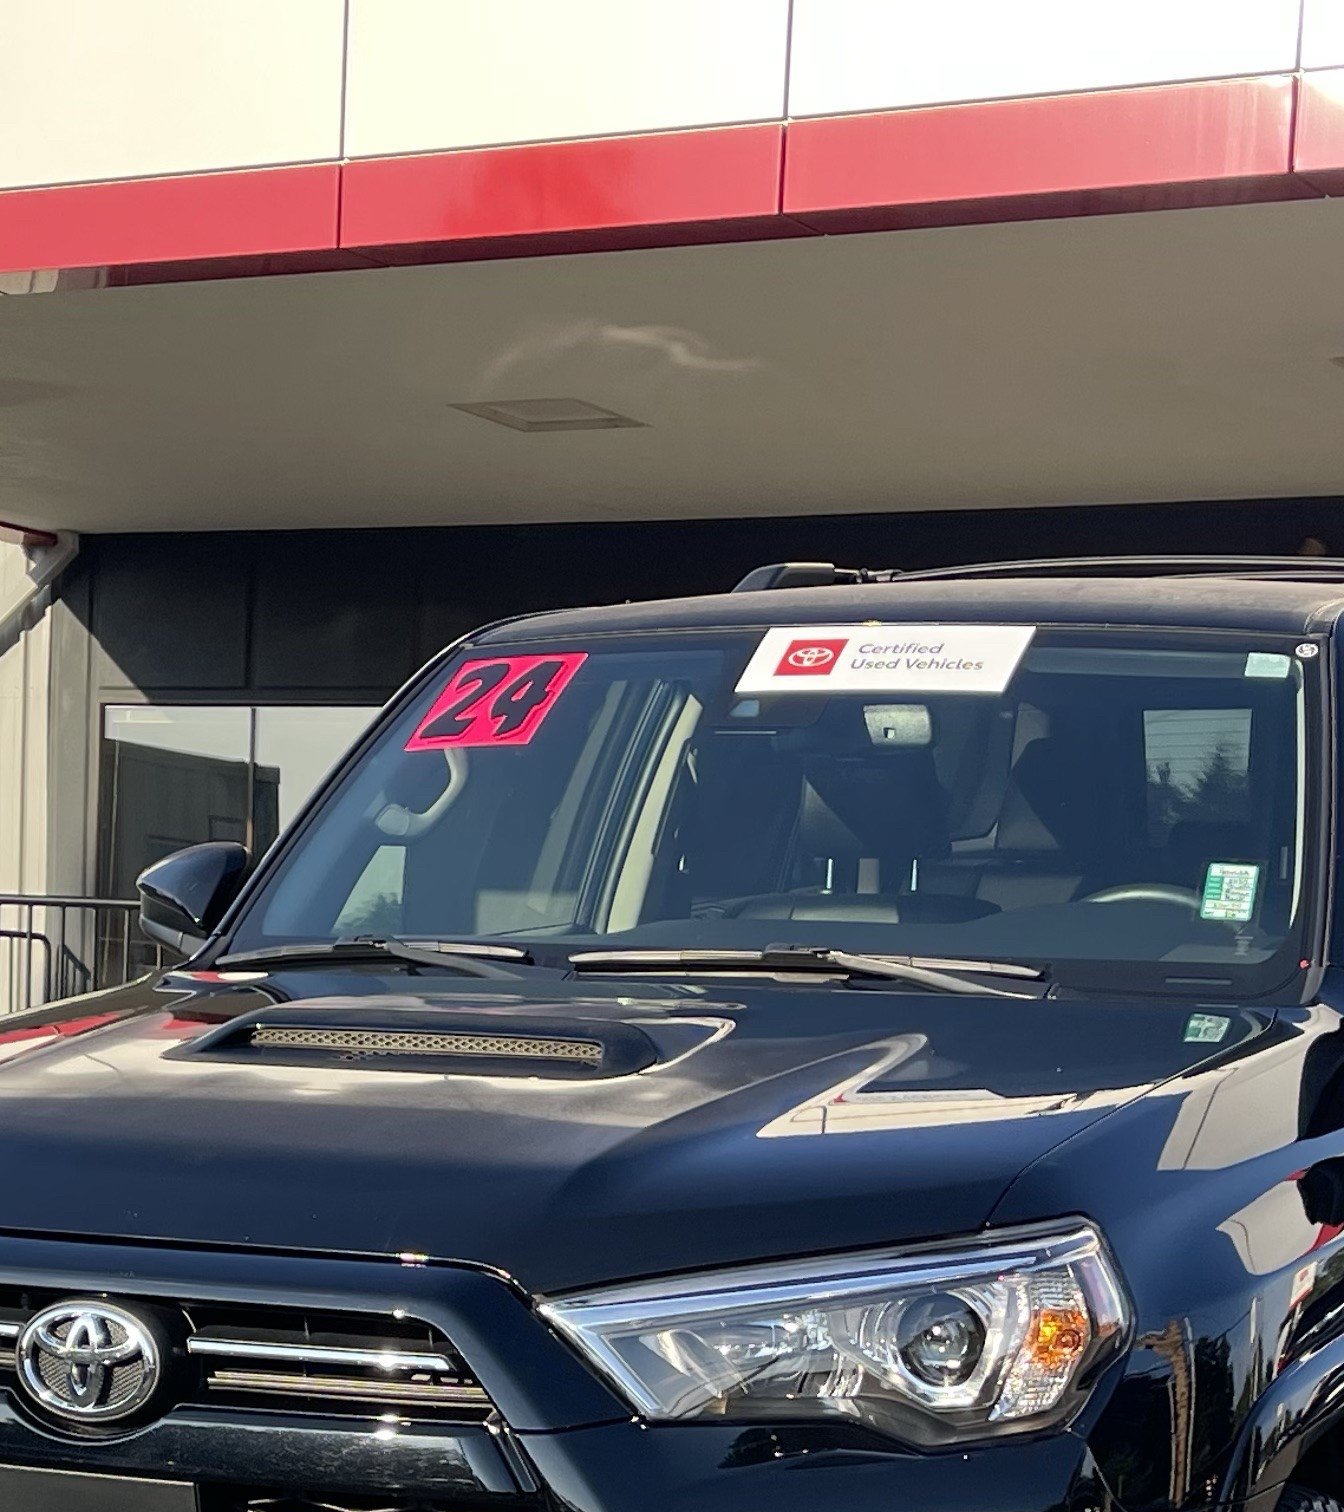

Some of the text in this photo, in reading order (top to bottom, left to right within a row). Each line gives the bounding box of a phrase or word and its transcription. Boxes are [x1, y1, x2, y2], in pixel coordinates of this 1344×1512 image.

[858, 642, 945, 655] Certified
[850, 658, 985, 671] Used Vehicles
[419, 661, 567, 740] 24
